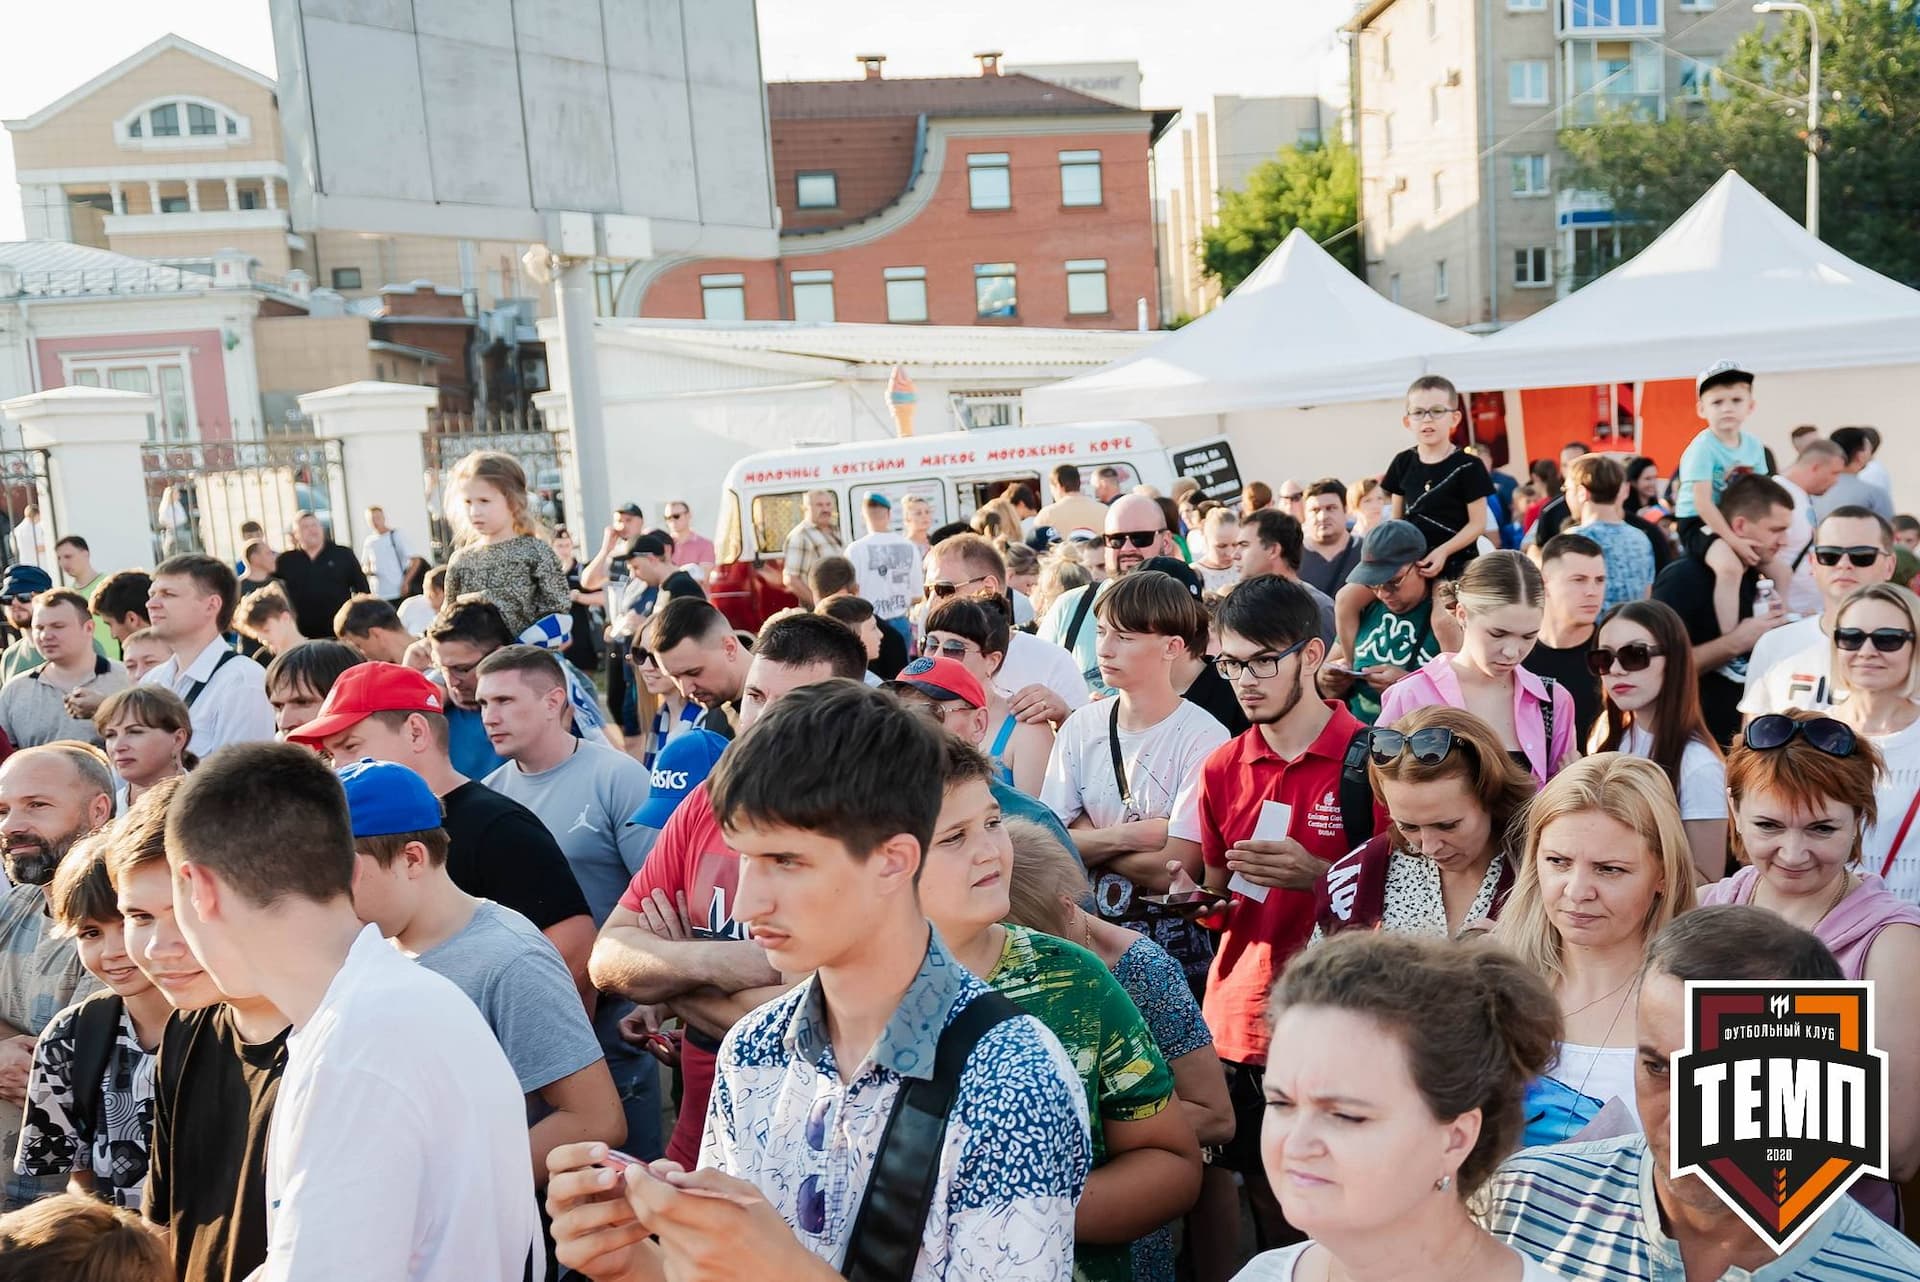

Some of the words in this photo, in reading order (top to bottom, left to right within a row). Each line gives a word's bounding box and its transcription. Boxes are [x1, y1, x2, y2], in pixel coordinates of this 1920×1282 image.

[744, 466, 820, 483] МОЛОЧНЫЕ
[832, 457, 905, 475] КОКТЕЙЛИ
[920, 451, 975, 467] МЯГКОЕ
[987, 442, 1075, 461] МОРОЖЕНОЕ
[1090, 437, 1134, 453] КОФЕ
